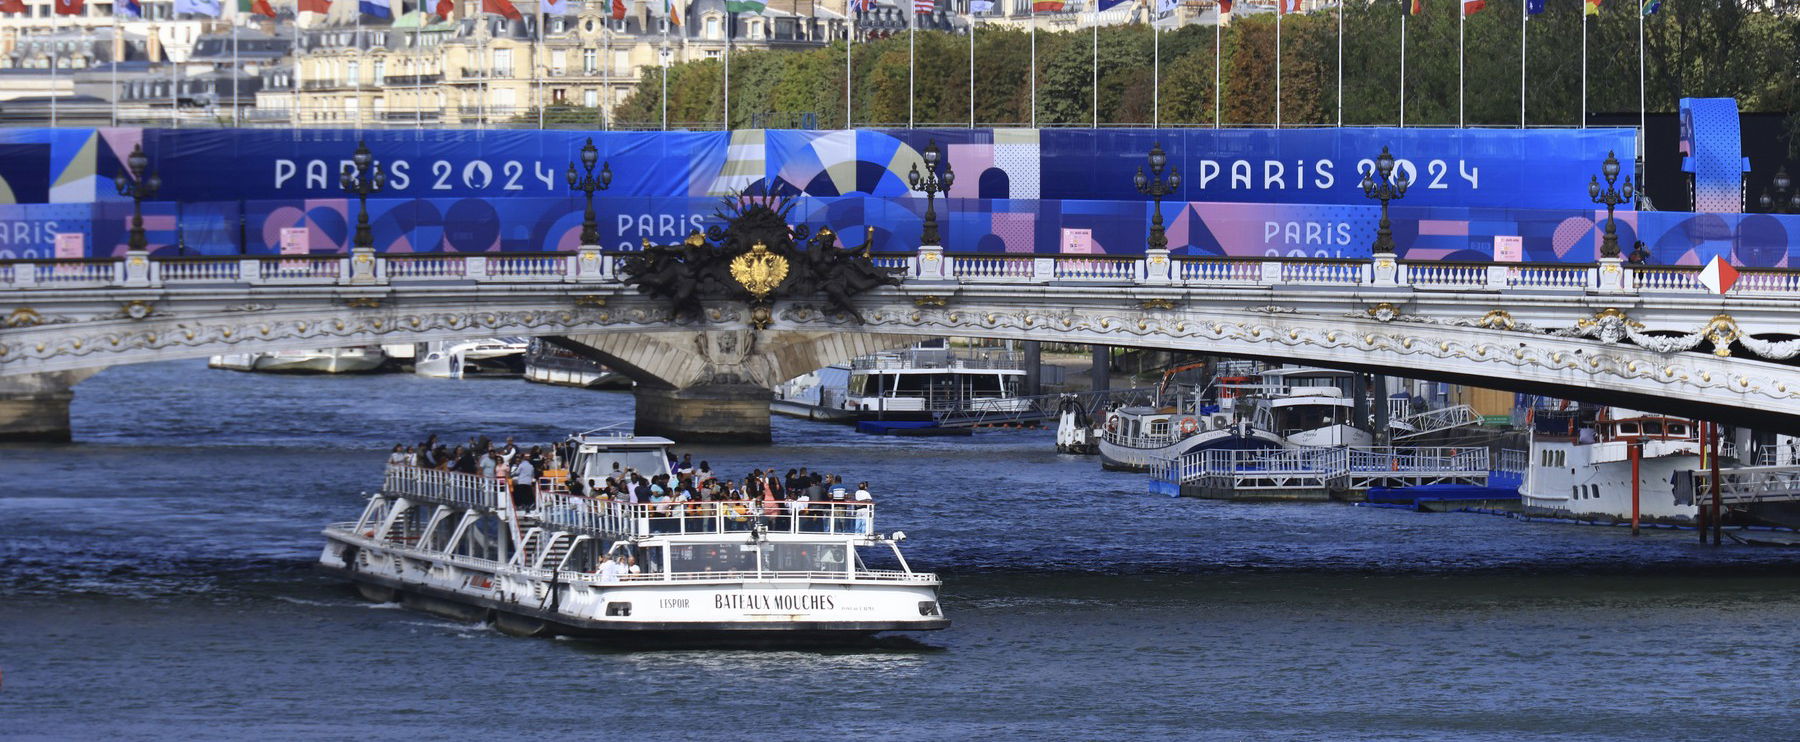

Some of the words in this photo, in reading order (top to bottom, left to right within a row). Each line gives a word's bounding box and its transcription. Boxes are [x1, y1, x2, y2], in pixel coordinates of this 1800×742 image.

[432, 160, 554, 191] 2024
[1357, 158, 1478, 189] 2024
[715, 594, 770, 610] BATEAUX
[774, 594, 834, 610] MOUCHES
